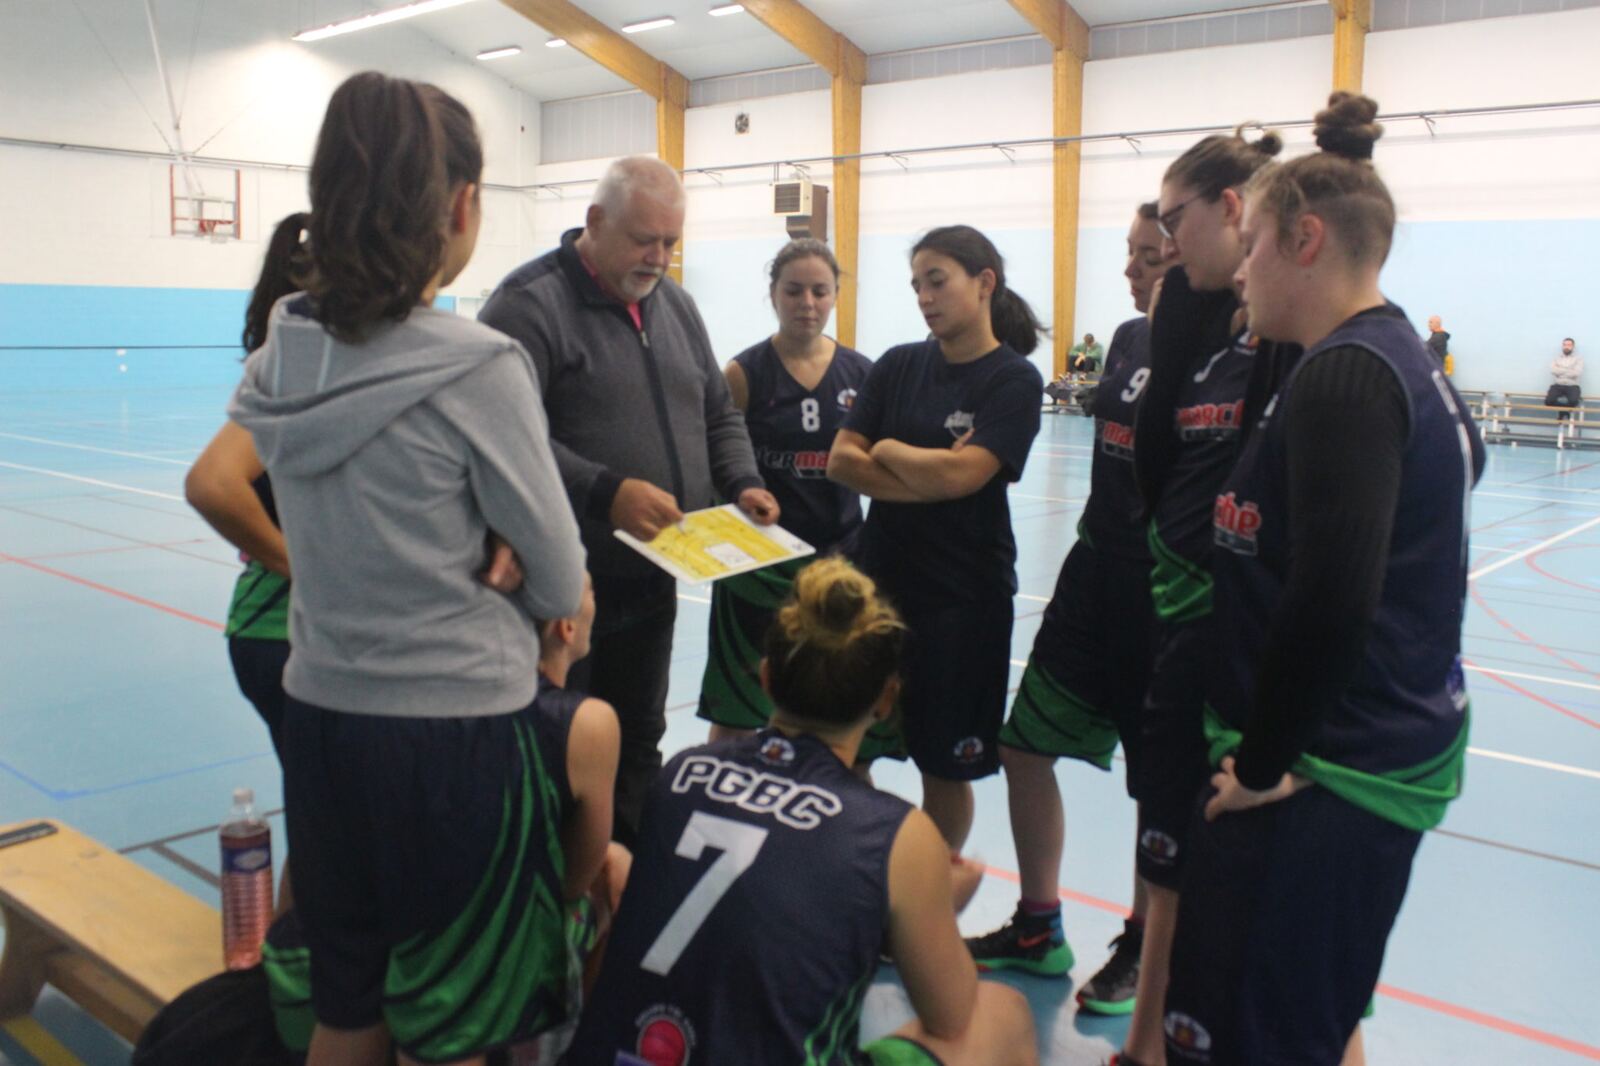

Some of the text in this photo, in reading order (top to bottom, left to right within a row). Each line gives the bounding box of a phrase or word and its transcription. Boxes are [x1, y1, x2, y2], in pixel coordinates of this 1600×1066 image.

[1121, 367, 1151, 402] 9
[801, 398, 820, 432] 8
[671, 756, 842, 830] PGBC
[640, 810, 769, 977] 7
